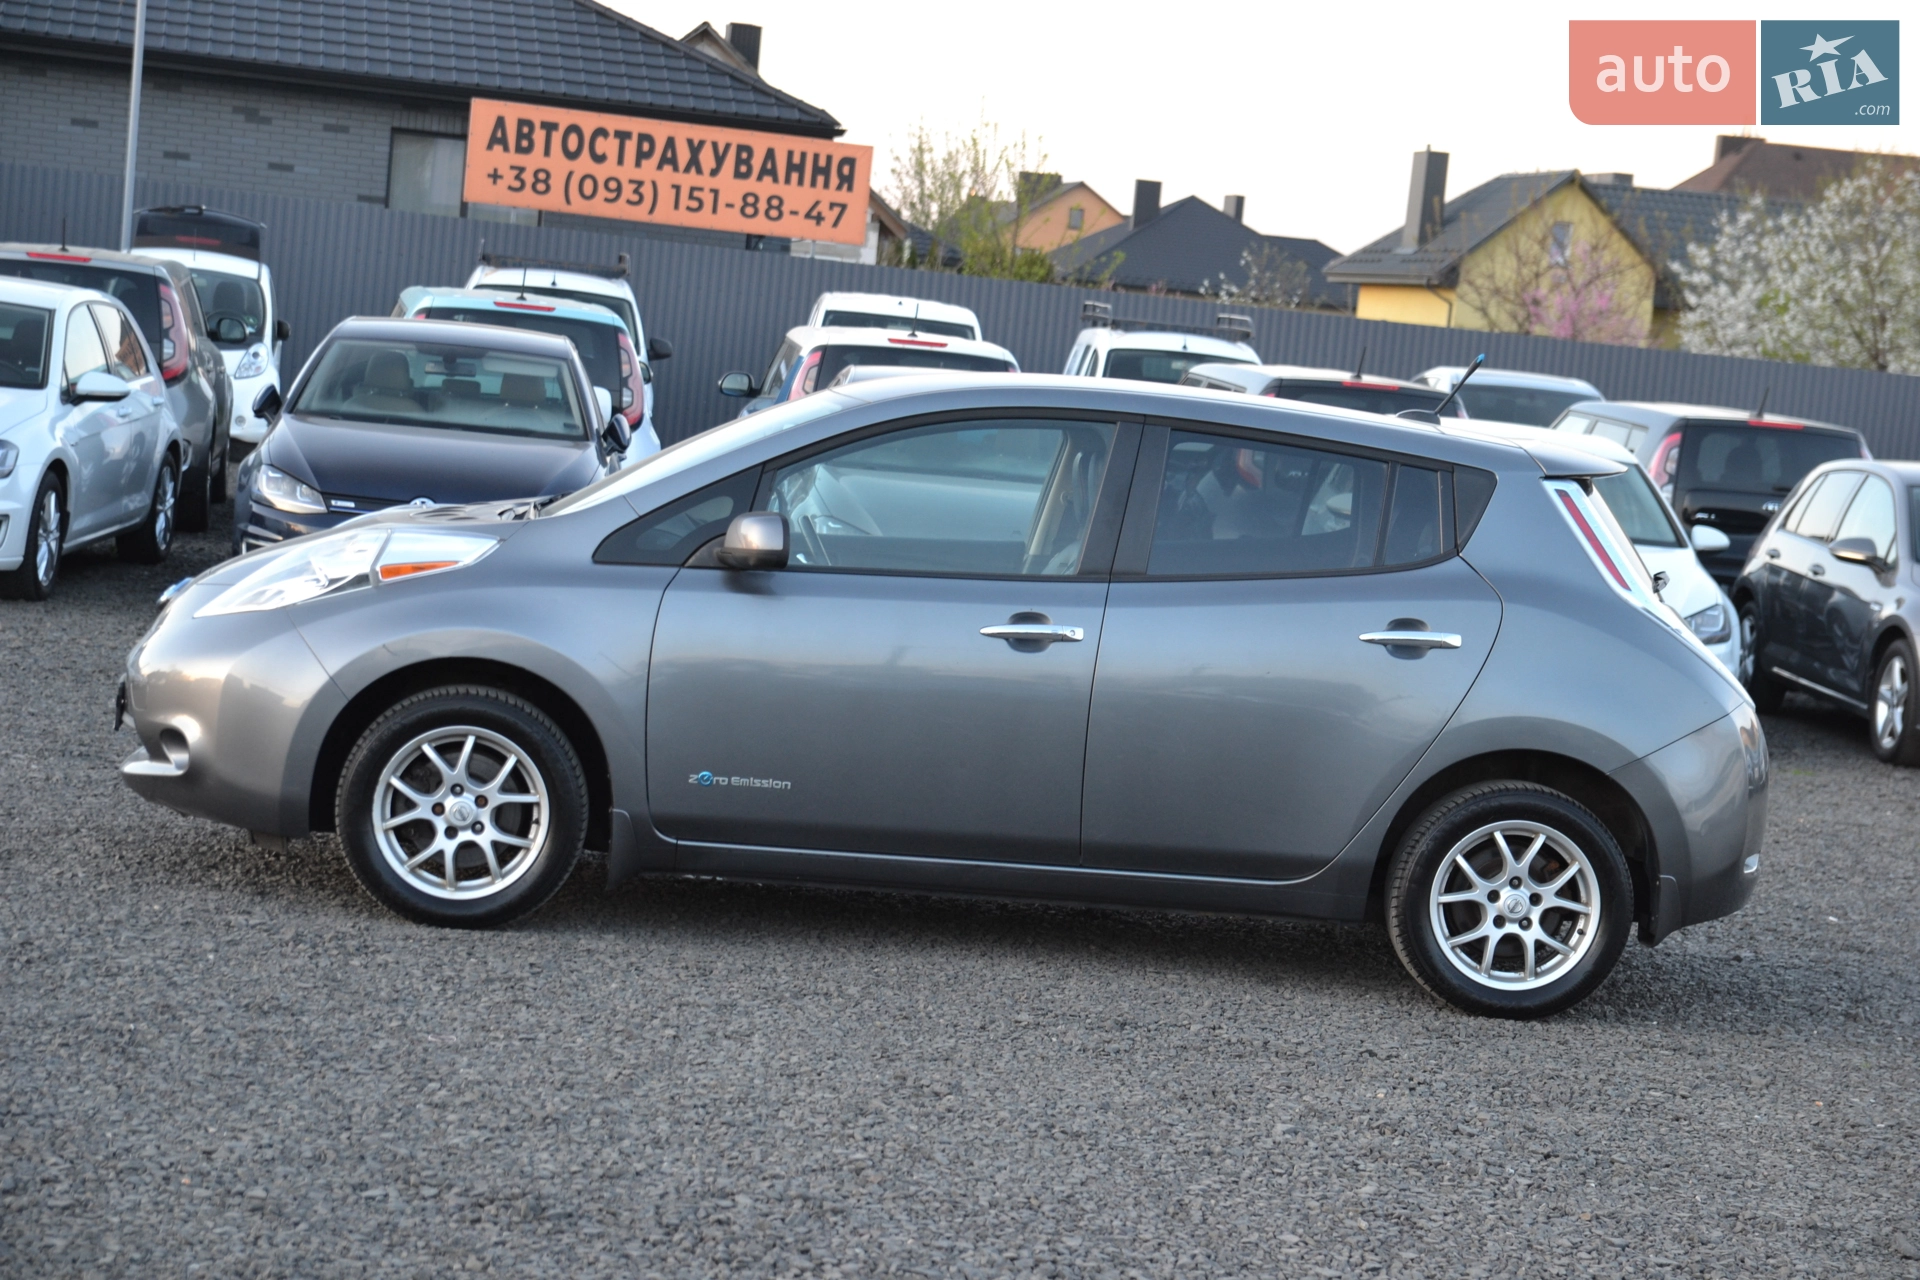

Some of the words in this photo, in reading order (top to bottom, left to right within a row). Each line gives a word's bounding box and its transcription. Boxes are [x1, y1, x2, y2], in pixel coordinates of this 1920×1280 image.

[486, 115, 857, 193] АВТОСТРАХУВАННЯ
[487, 165, 552, 195] +38
[563, 171, 659, 215] (093)
[671, 184, 848, 229] 151-88-47
